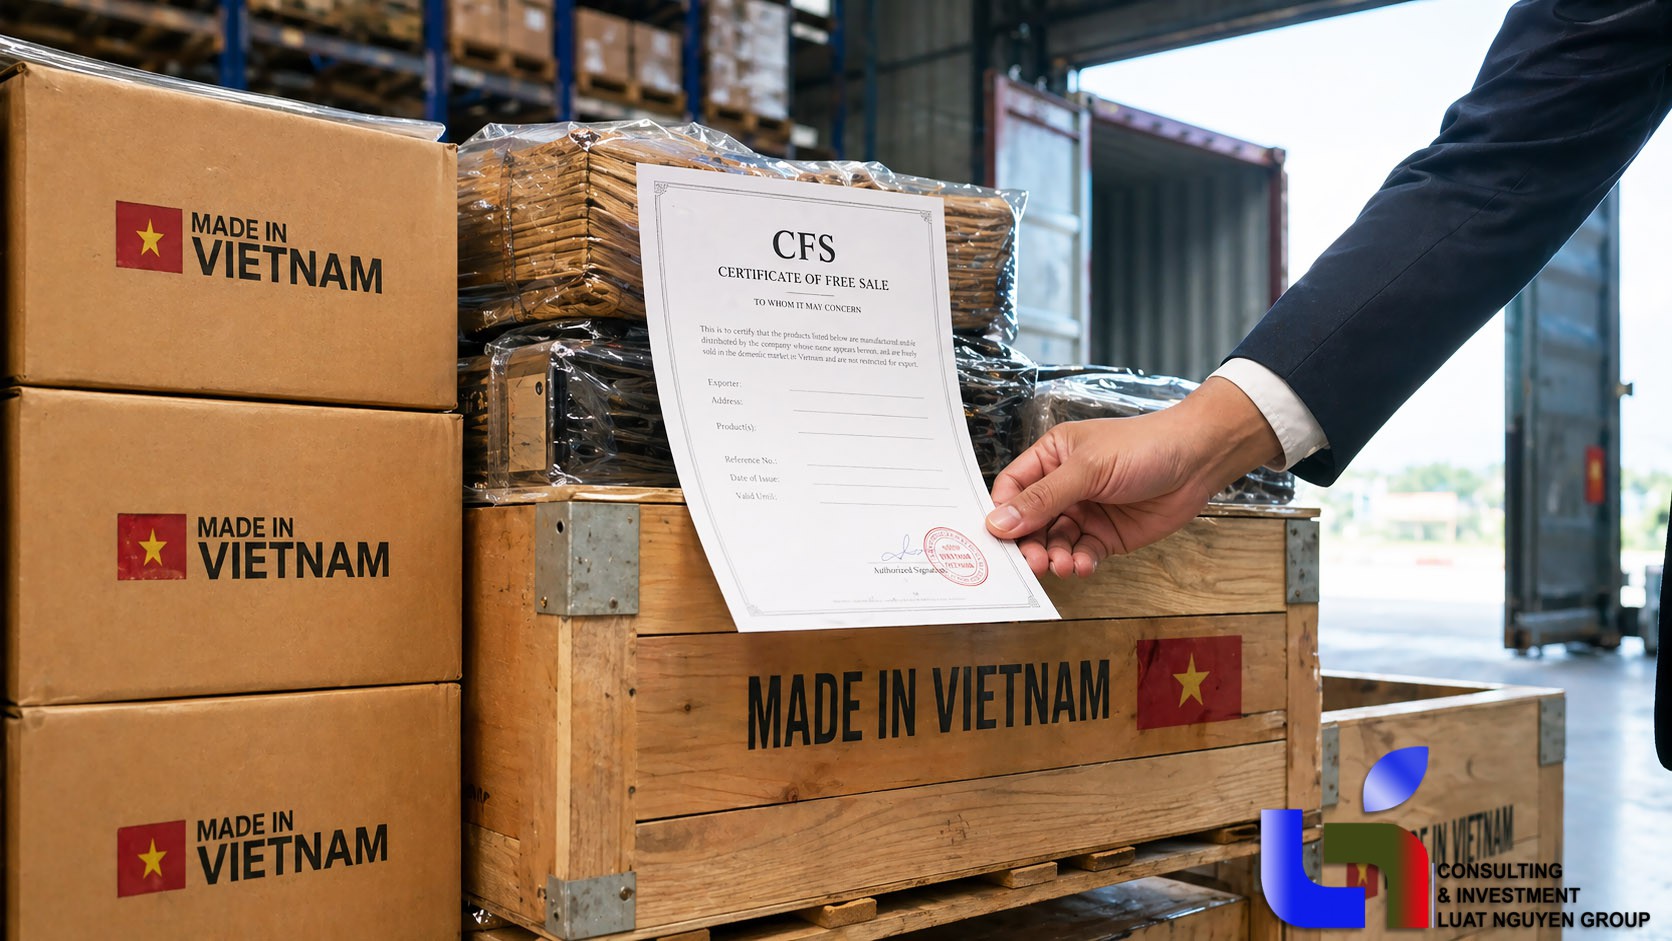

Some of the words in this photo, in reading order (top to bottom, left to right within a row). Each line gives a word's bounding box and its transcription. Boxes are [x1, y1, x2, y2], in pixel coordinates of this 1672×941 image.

[192, 211, 259, 241] MADE
[266, 221, 287, 243] IN
[773, 229, 836, 263] CFS
[192, 236, 383, 294] VIETNAM
[717, 265, 802, 284] CERTIFICATE
[805, 273, 821, 286] OF
[825, 275, 856, 288] FREE
[859, 277, 890, 291] SALE
[754, 298, 766, 306] TO
[767, 299, 795, 308] WHOM
[805, 303, 822, 311] MAY
[824, 304, 862, 313] CONCERN
[700, 325, 716, 333] This
[733, 328, 755, 337] certify
[783, 331, 811, 340] products
[830, 334, 848, 342] below
[738, 338, 747, 347] by
[748, 339, 759, 347] the
[761, 341, 792, 351] company
[702, 347, 717, 356] sold
[738, 350, 766, 359] domestic
[767, 352, 790, 360] market
[825, 355, 837, 363] and
[708, 378, 742, 388] Exporter:
[711, 397, 744, 406] Address:
[716, 422, 757, 432] Product(s):
[725, 456, 760, 465] Reference
[762, 457, 778, 465] No.:
[730, 474, 748, 482] Date
[750, 474, 758, 482] of
[759, 474, 780, 483] Issue:
[735, 492, 755, 500] Valid
[198, 516, 266, 538] MADE
[272, 517, 294, 539] IN
[198, 541, 390, 580] VIETNAM
[874, 566, 912, 575] Authorized
[747, 670, 864, 751] MADE
[878, 667, 917, 740] IN
[931, 659, 1110, 734] VIETNAM
[198, 812, 266, 843] MADE
[272, 809, 294, 834] IN
[1452, 804, 1514, 866] VIETNAM
[197, 823, 388, 886] VIETNAM
